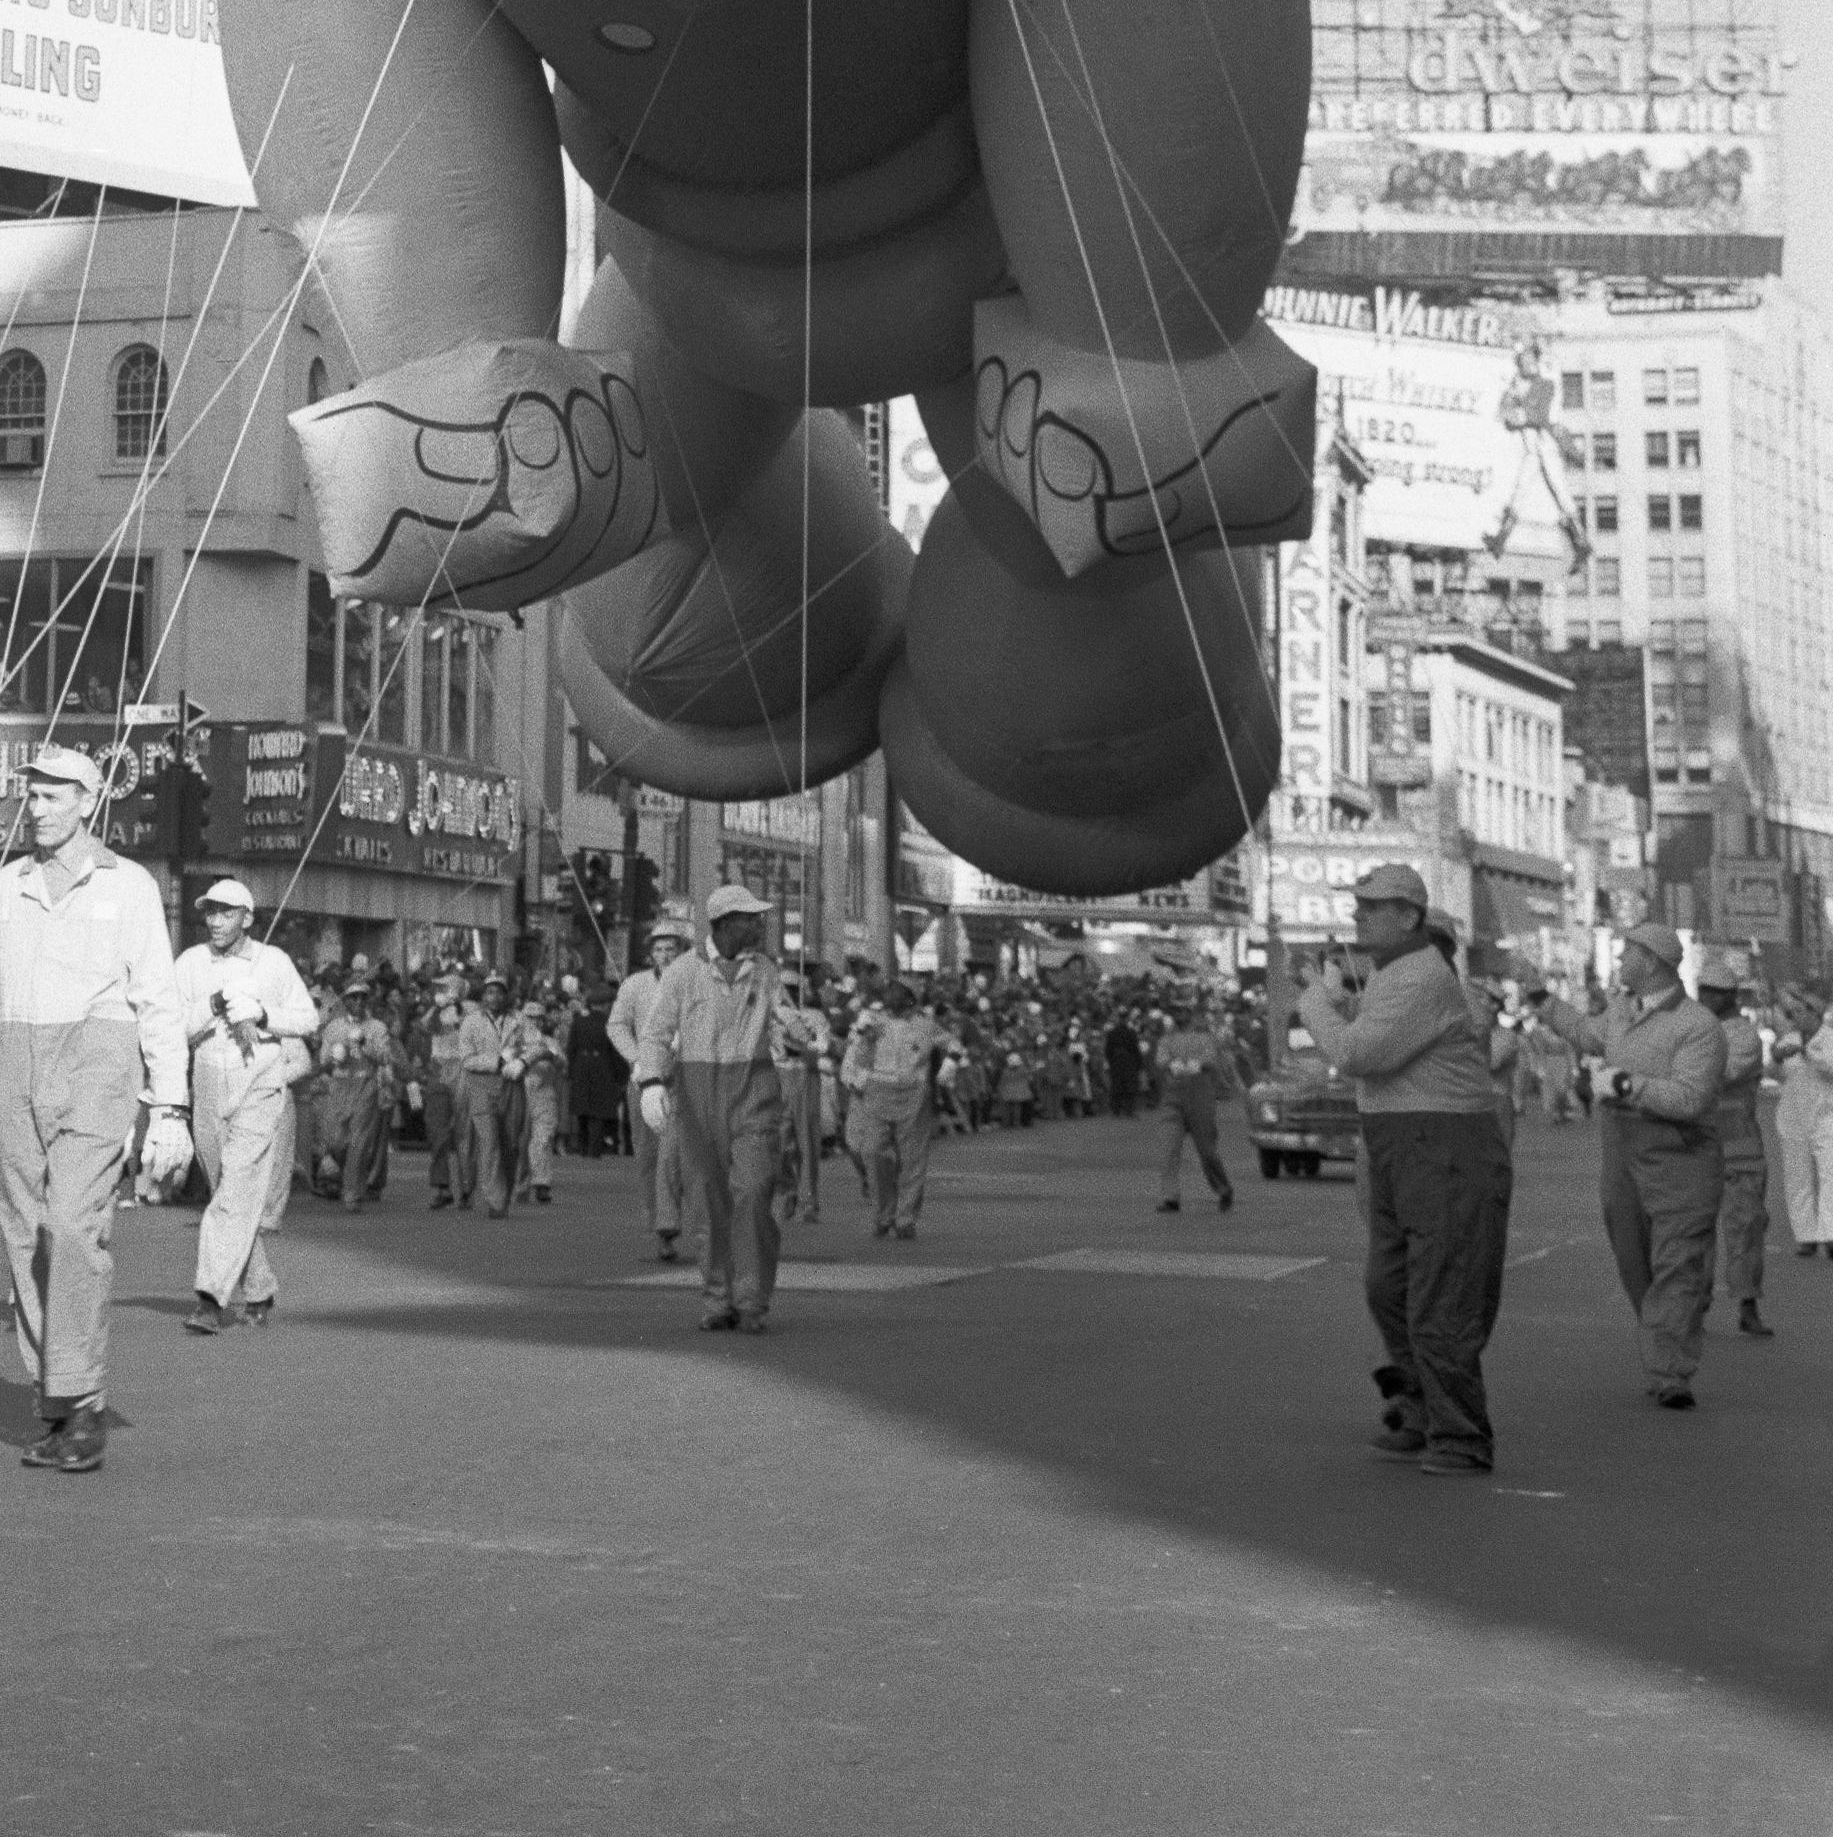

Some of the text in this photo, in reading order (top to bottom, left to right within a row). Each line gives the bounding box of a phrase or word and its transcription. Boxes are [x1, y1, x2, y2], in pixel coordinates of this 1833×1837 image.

[36, 111, 65, 127] BACK
[1257, 285, 1500, 346] OHNNIE WALKER
[1262, 855, 1420, 884] POR
